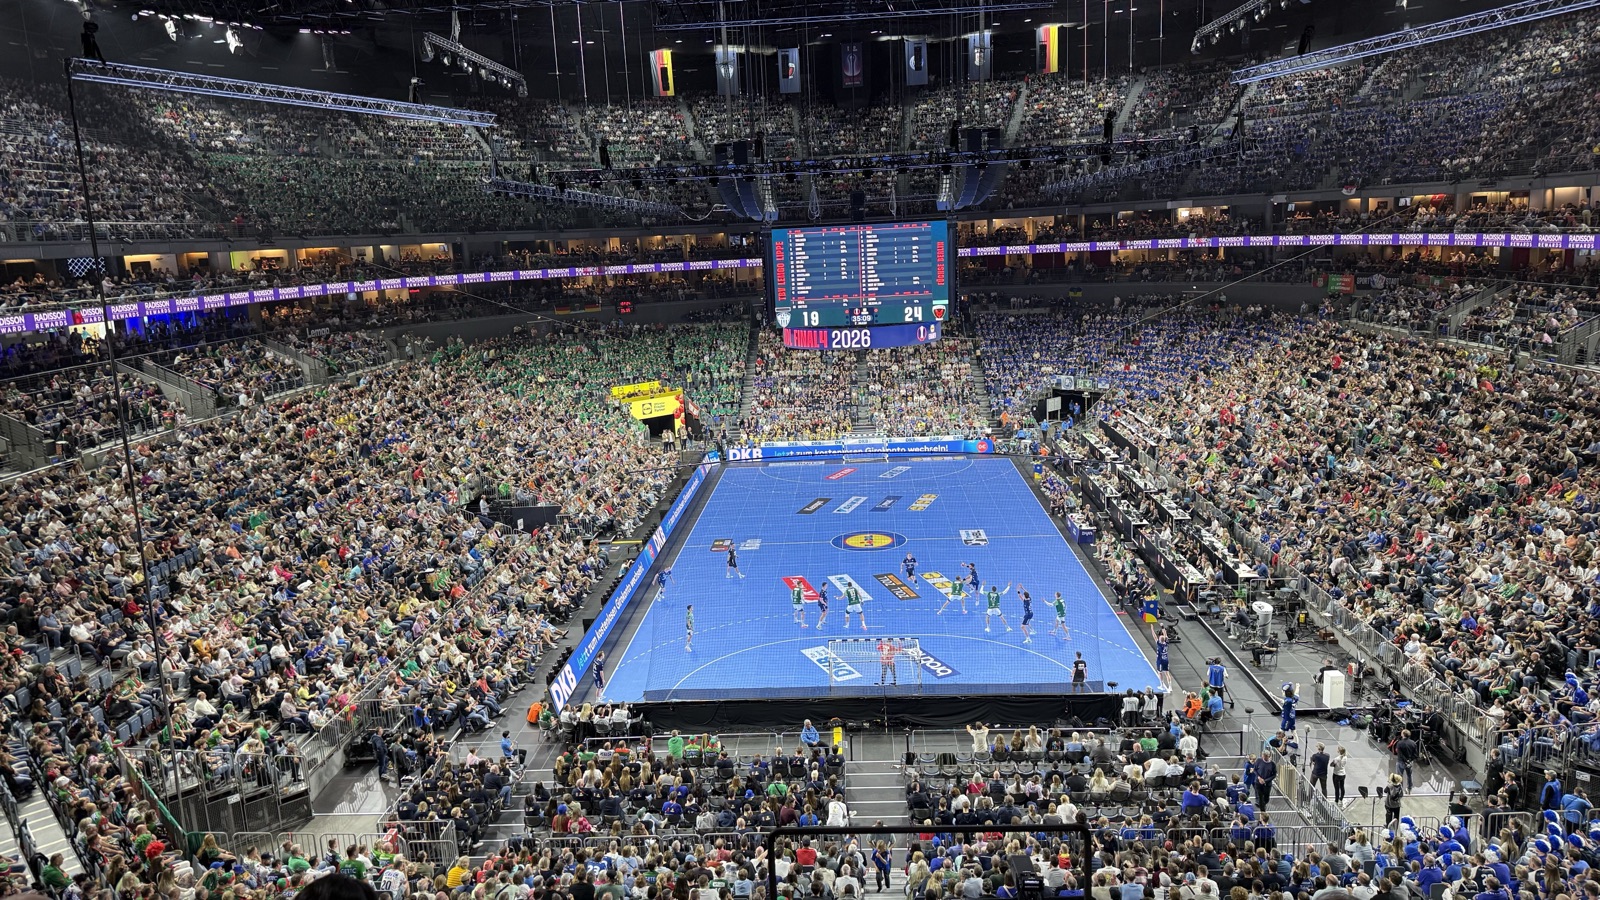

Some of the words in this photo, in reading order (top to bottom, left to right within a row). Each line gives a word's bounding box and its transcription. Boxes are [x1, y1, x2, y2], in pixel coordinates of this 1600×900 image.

[775, 241, 784, 260] LIPPE
[936, 241, 944, 262] BERLIN
[776, 263, 786, 285] LEMGO
[326, 282, 348, 290] RADISSON
[381, 278, 401, 286] RADISSON
[777, 288, 786, 301] TBV
[144, 300, 170, 309] RADISSON
[175, 298, 198, 306] RADISSON
[81, 308, 104, 316] DISSON
[111, 304, 138, 313] RADISSON
[904, 306, 922, 321] 24
[0, 315, 25, 326] DISSON
[34, 312, 66, 322] RADISSON
[803, 311, 819, 326] 19
[1, 326, 26, 334] WARDS
[36, 321, 68, 330] REWARDS
[793, 329, 828, 348] FINAL4
[832, 330, 870, 348] 2026
[730, 449, 763, 461] DKB
[652, 525, 666, 553] DKB
[550, 664, 576, 715] DKB
[576, 648, 590, 670] Jetzt
[588, 636, 598, 654] zum
[595, 606, 616, 640] kostenlosen
[615, 585, 632, 610] Girokonto
[587, 865, 600, 875] 23
[381, 879, 391, 890] 20
